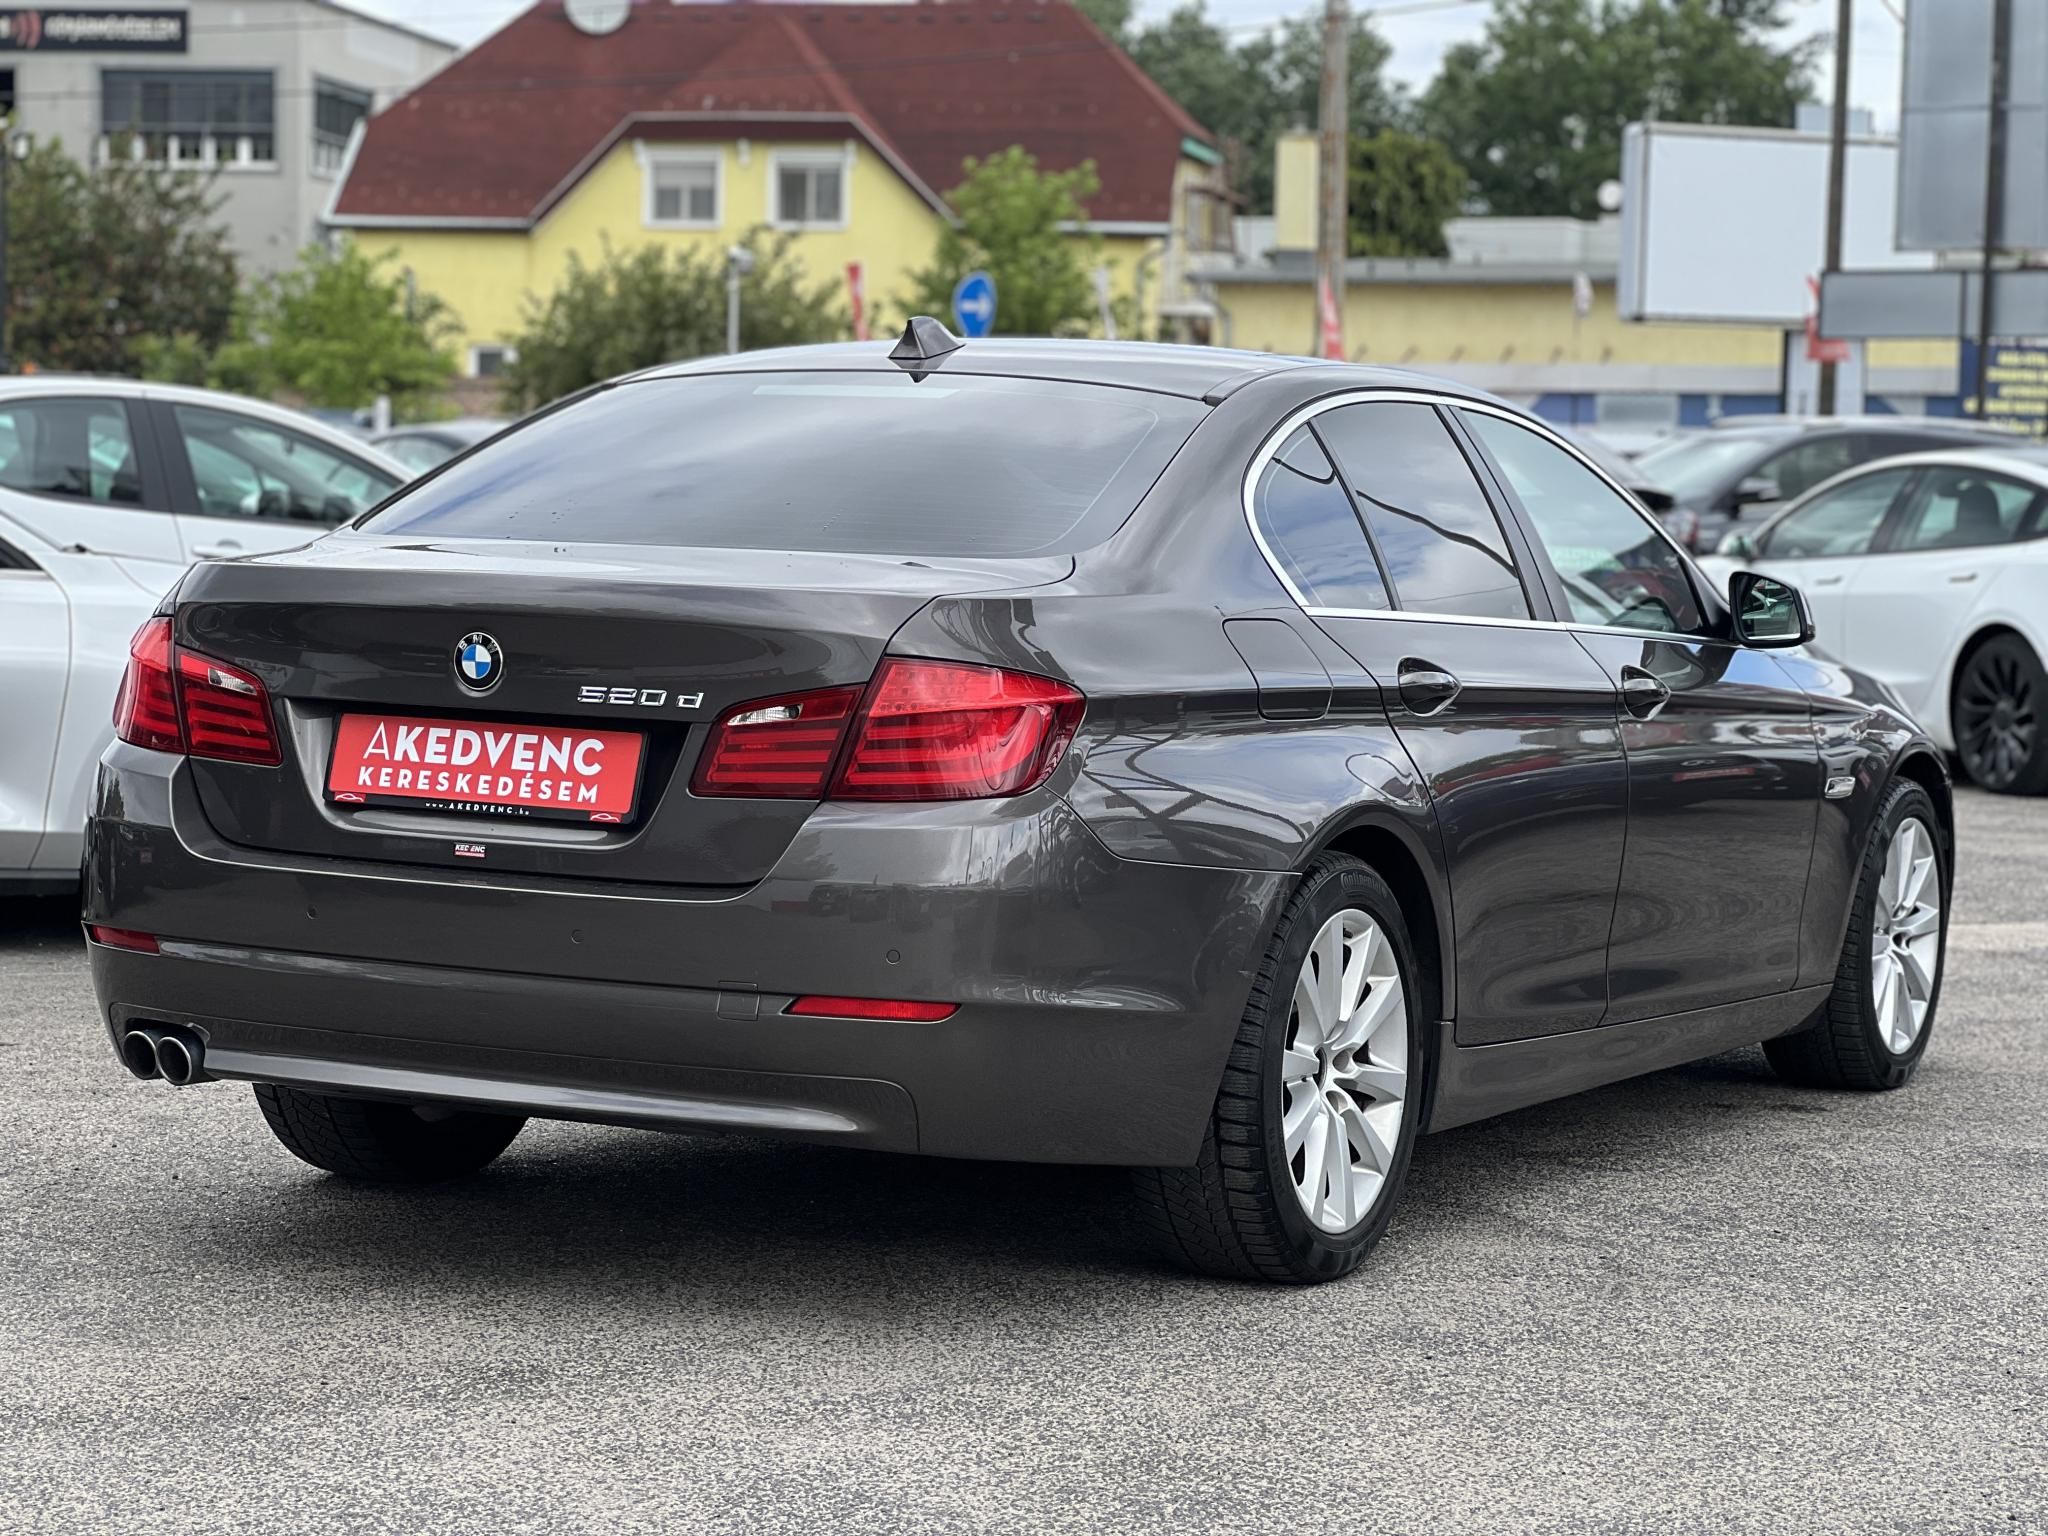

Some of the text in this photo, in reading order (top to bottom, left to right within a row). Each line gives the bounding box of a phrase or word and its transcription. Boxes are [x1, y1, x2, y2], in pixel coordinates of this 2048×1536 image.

[458, 634, 499, 654] BMW
[577, 686, 704, 709] 520 d
[362, 721, 605, 776] AKEDVENC
[358, 766, 598, 804] KERESKEDÉSEM
